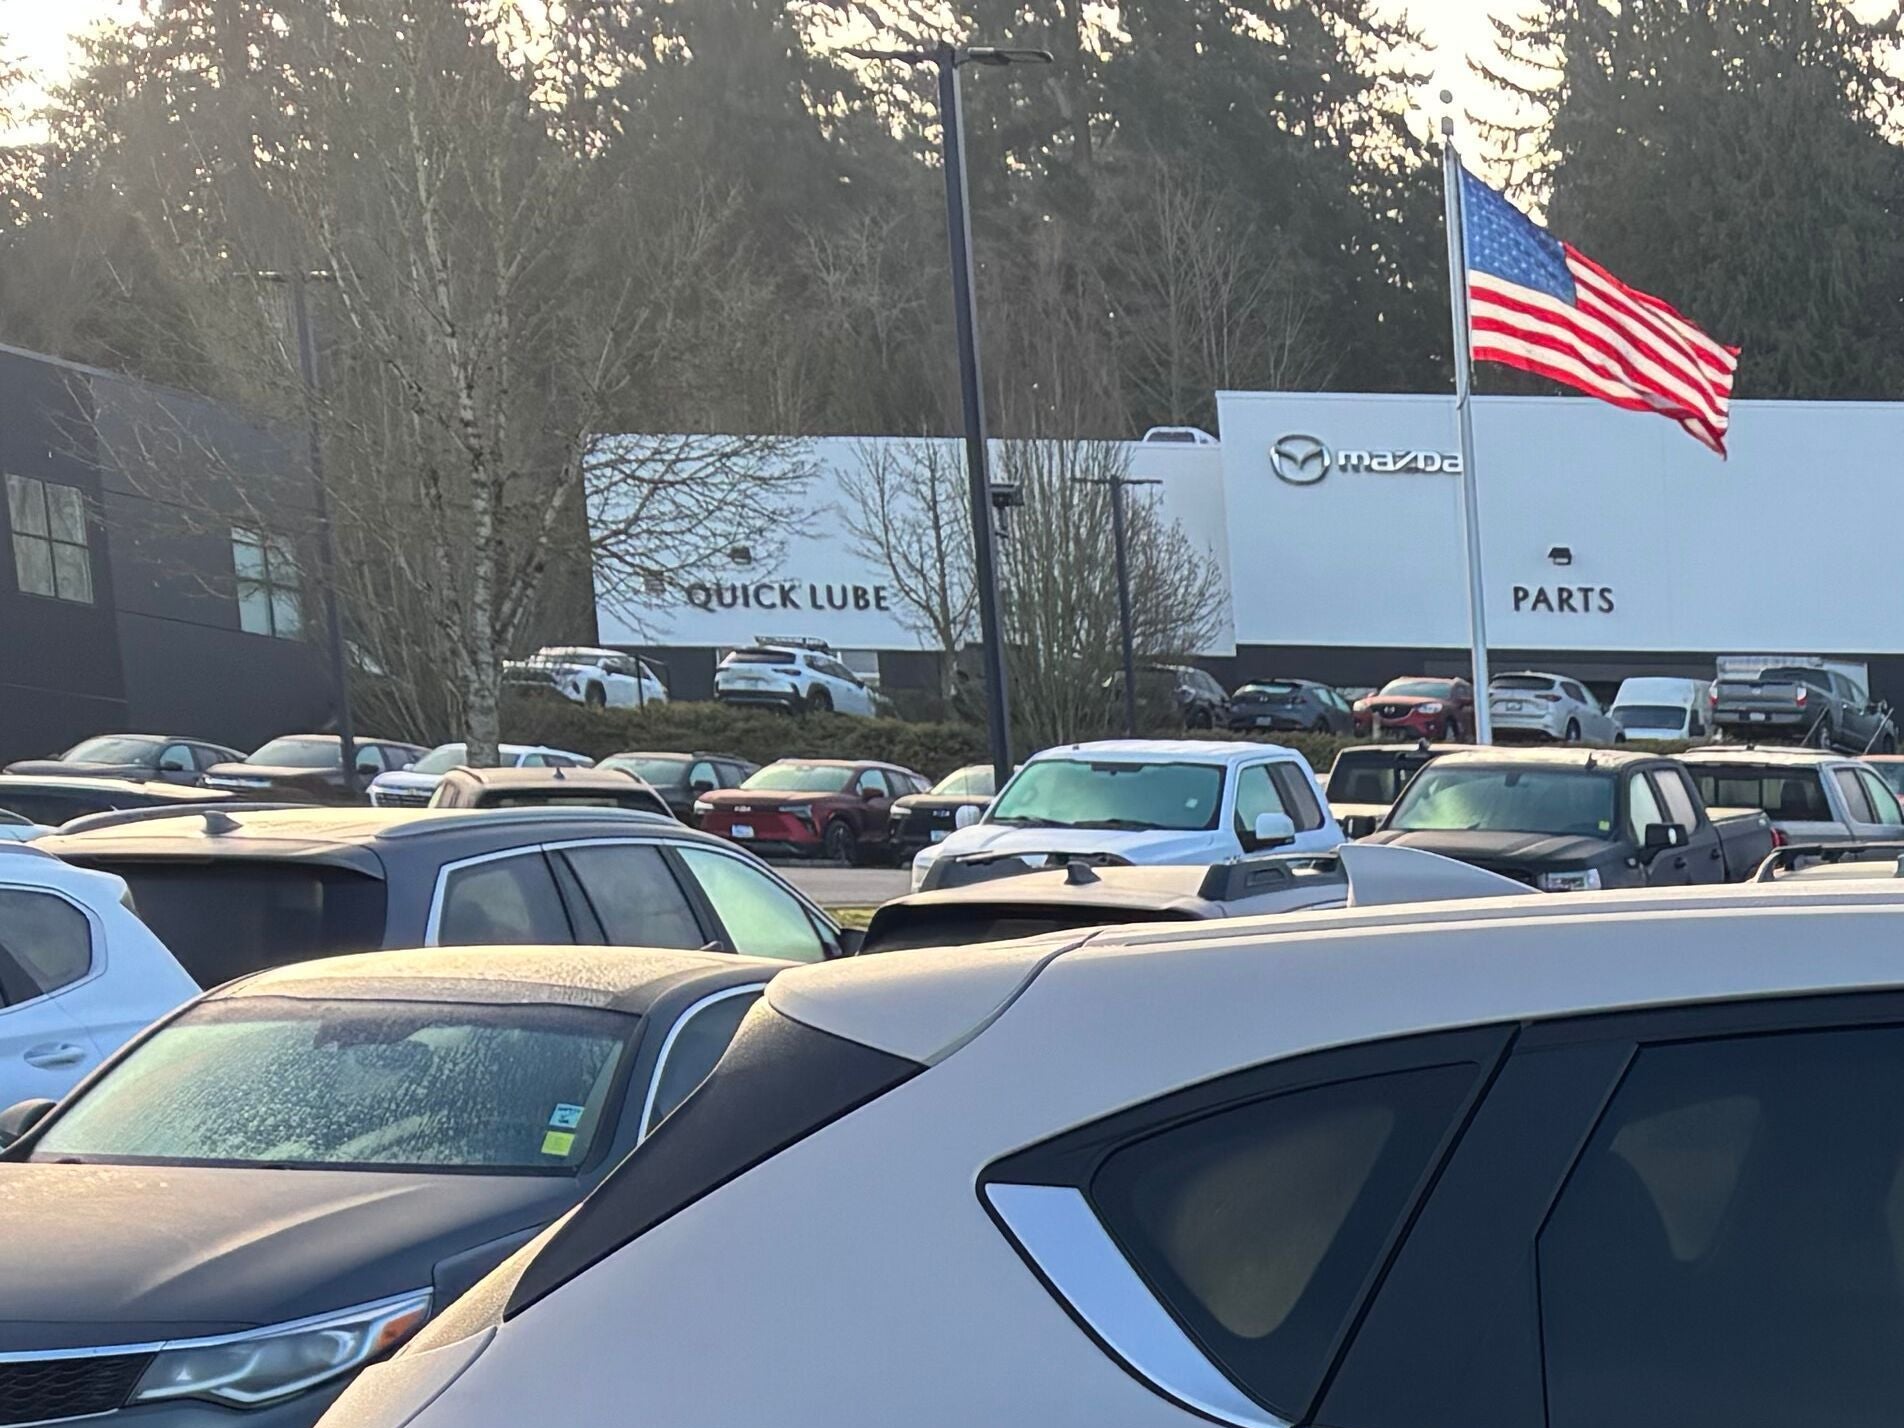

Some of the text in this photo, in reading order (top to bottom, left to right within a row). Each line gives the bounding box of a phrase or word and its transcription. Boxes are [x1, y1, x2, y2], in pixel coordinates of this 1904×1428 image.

[687, 582, 890, 613] QUICK LUBE
[1512, 586, 1615, 613] PARTS
